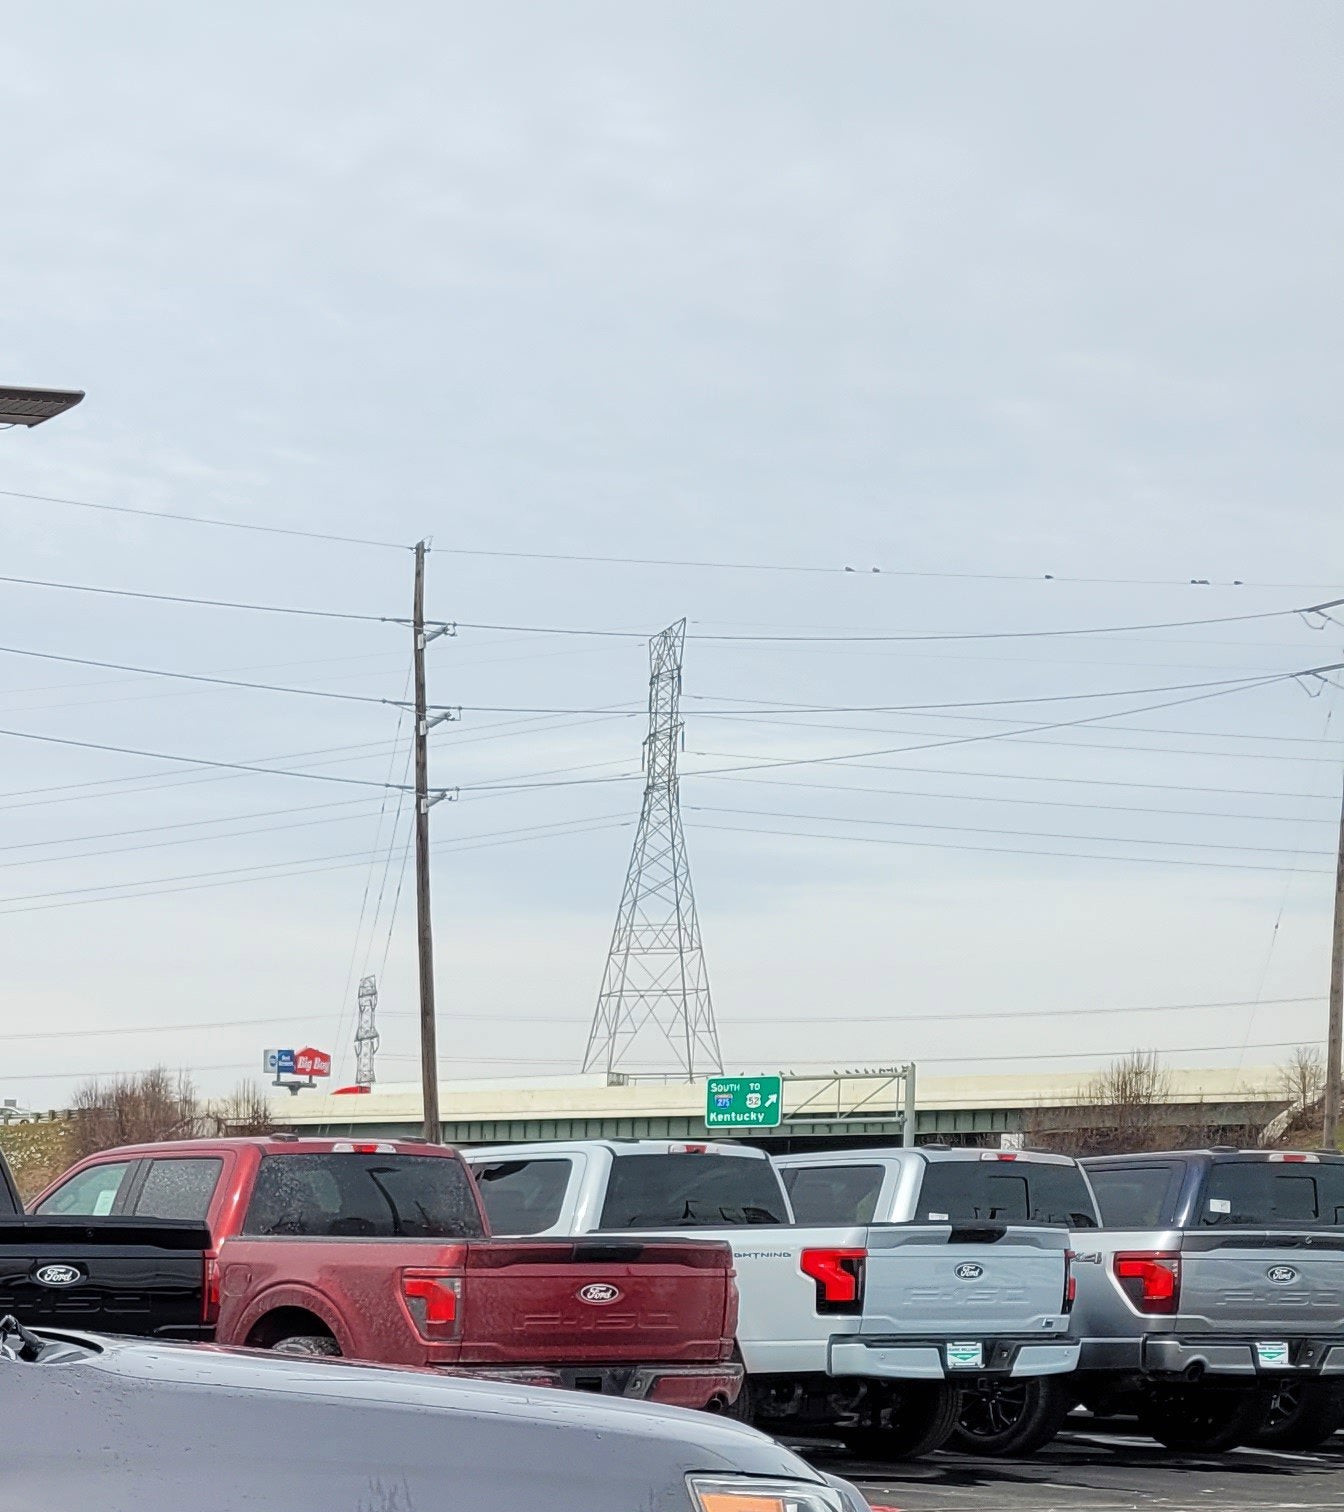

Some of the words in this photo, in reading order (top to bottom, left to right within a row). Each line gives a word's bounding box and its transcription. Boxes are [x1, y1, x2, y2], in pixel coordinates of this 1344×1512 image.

[297, 1056, 313, 1071] Big
[710, 1083, 740, 1092] SOUTH
[749, 1083, 761, 1091] TO
[716, 1098, 730, 1107] 275
[748, 1096, 760, 1106] 52
[709, 1111, 765, 1122] Kentucky
[733, 1252, 792, 1260] GHTNING
